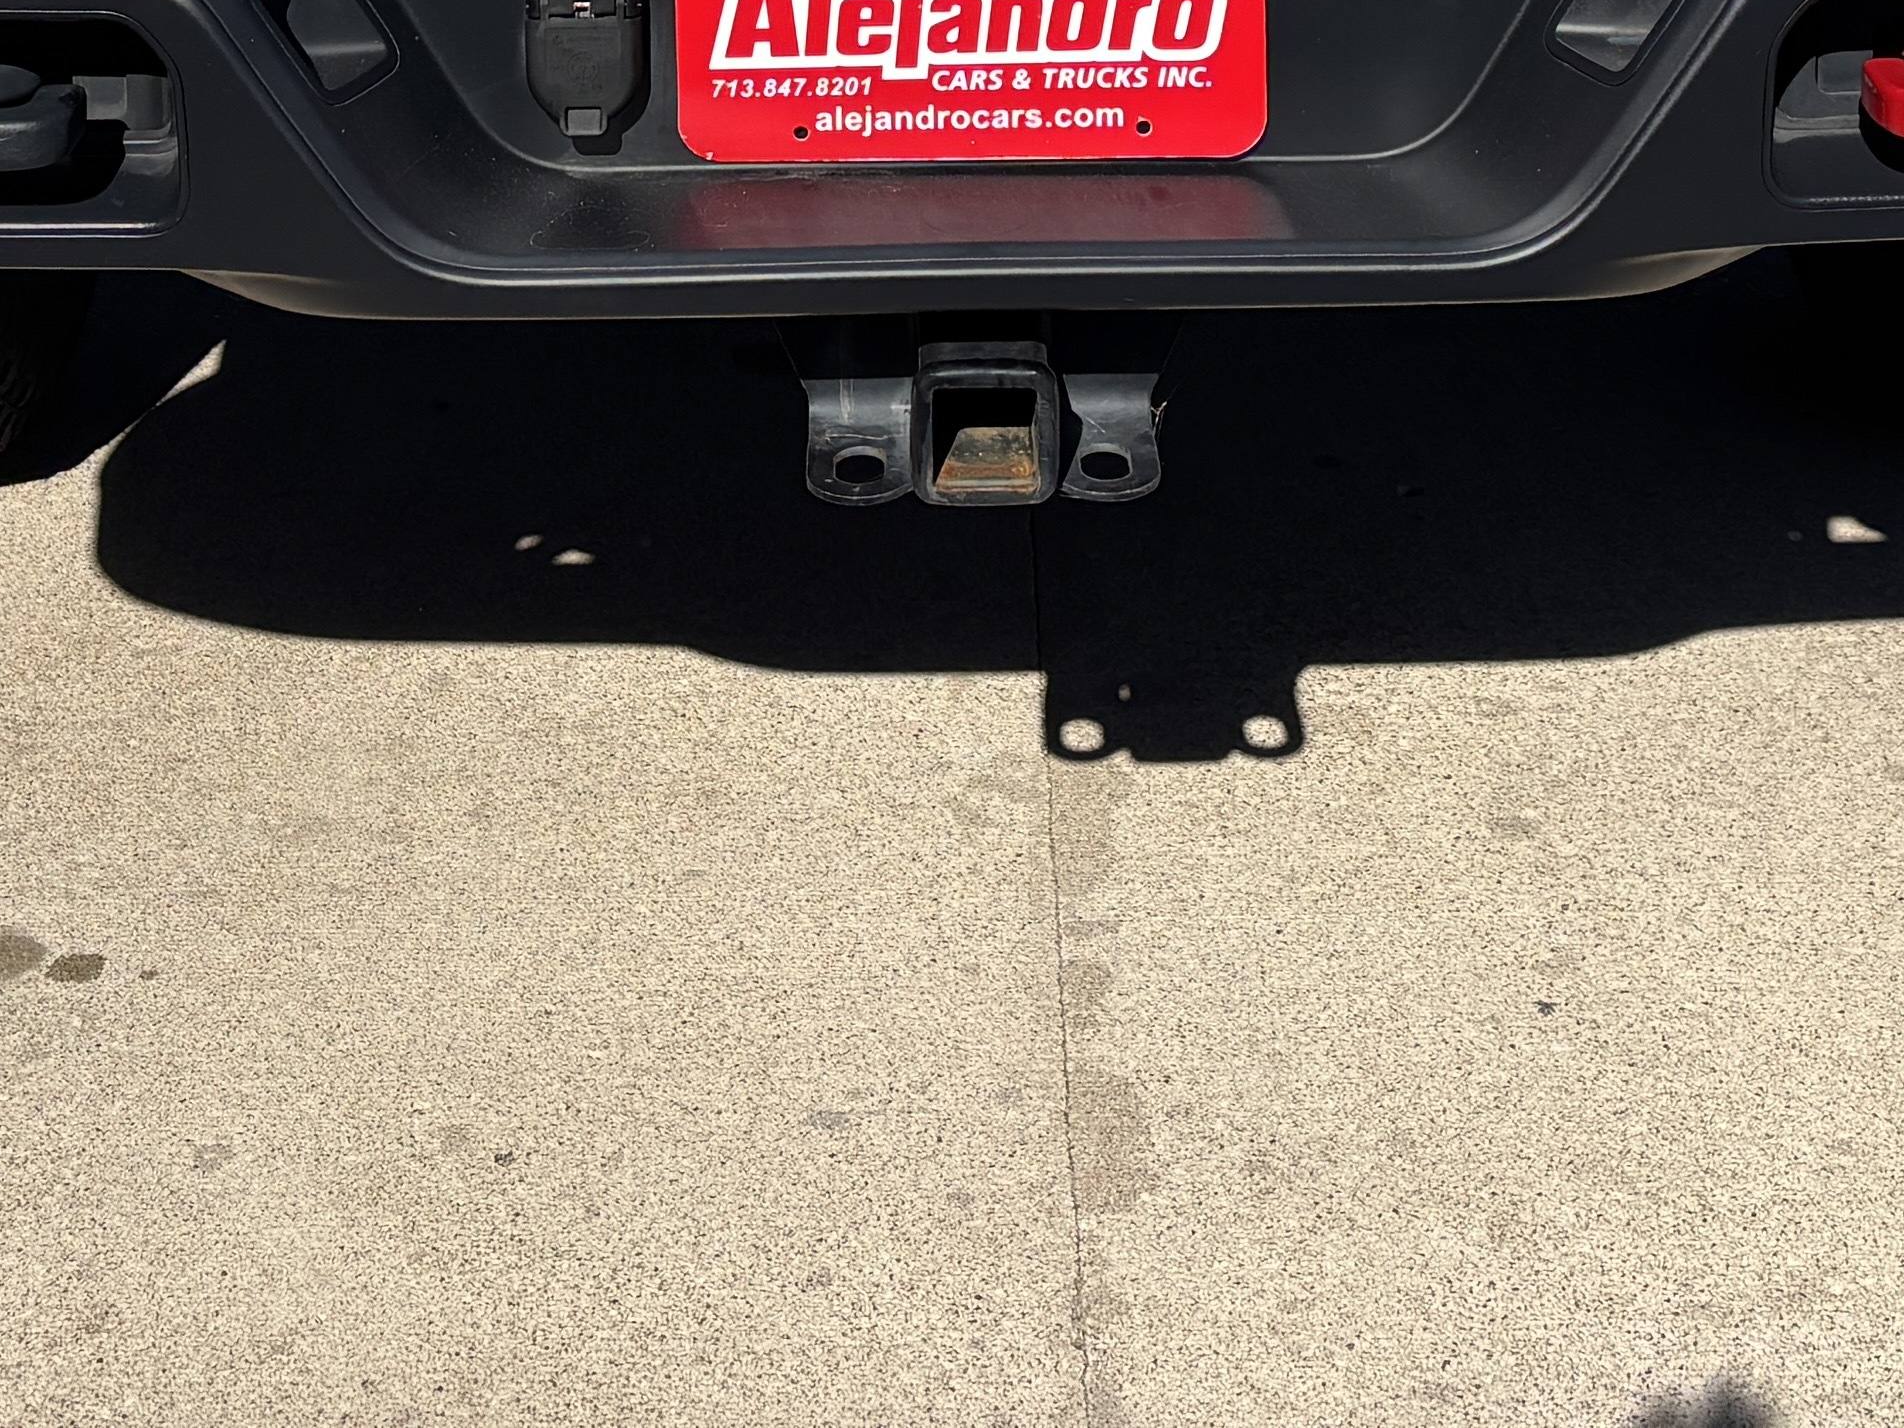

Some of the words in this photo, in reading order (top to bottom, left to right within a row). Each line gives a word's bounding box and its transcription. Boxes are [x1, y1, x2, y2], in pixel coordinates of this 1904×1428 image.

[711, 75, 873, 99] 713.847.8201
[930, 70, 1004, 93] CARS
[1011, 70, 1032, 92] &
[1041, 68, 1149, 91] TRUCKS
[1158, 66, 1213, 89] INC.
[814, 104, 1125, 137] alejandrocars.com
